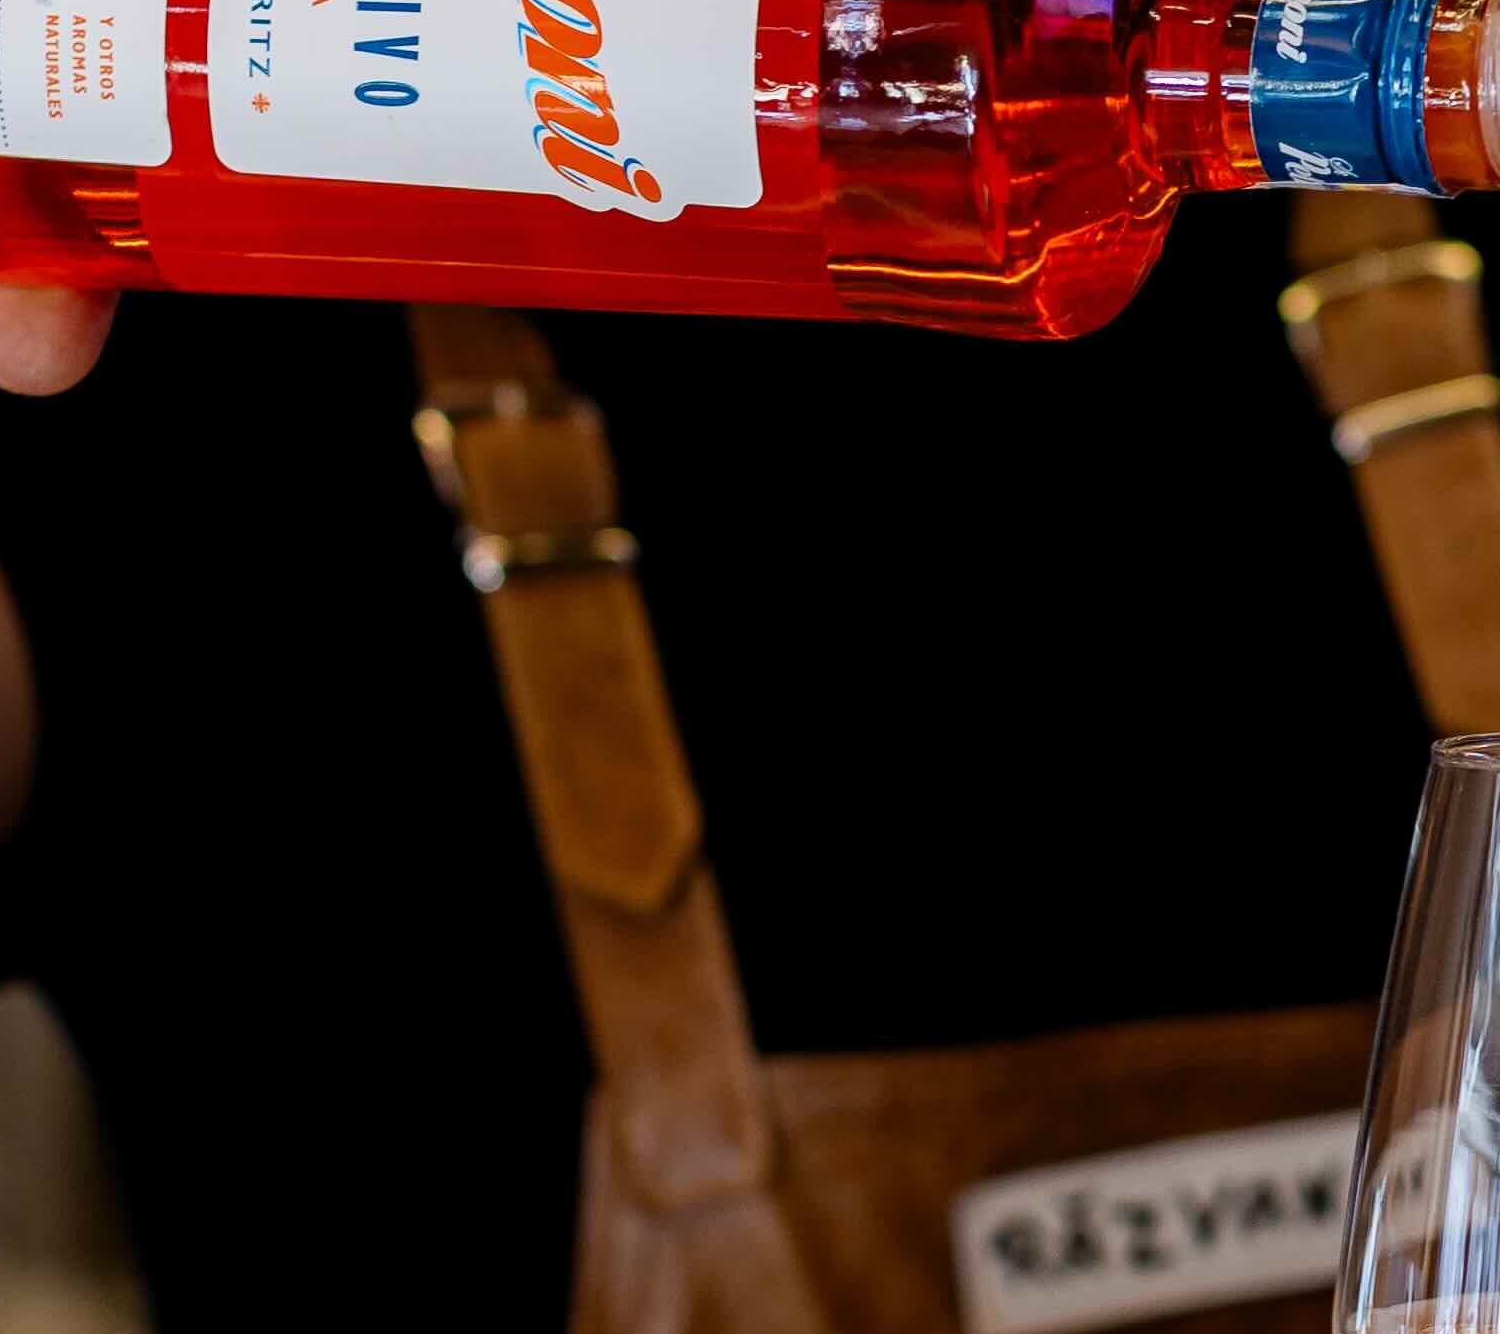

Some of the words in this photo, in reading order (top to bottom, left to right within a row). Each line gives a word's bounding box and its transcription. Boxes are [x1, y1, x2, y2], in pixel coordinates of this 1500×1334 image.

[71, 15, 88, 95] AROMAS
[99, 16, 116, 27] Y
[45, 15, 63, 120] NATURALES
[99, 37, 116, 101] OTROS
